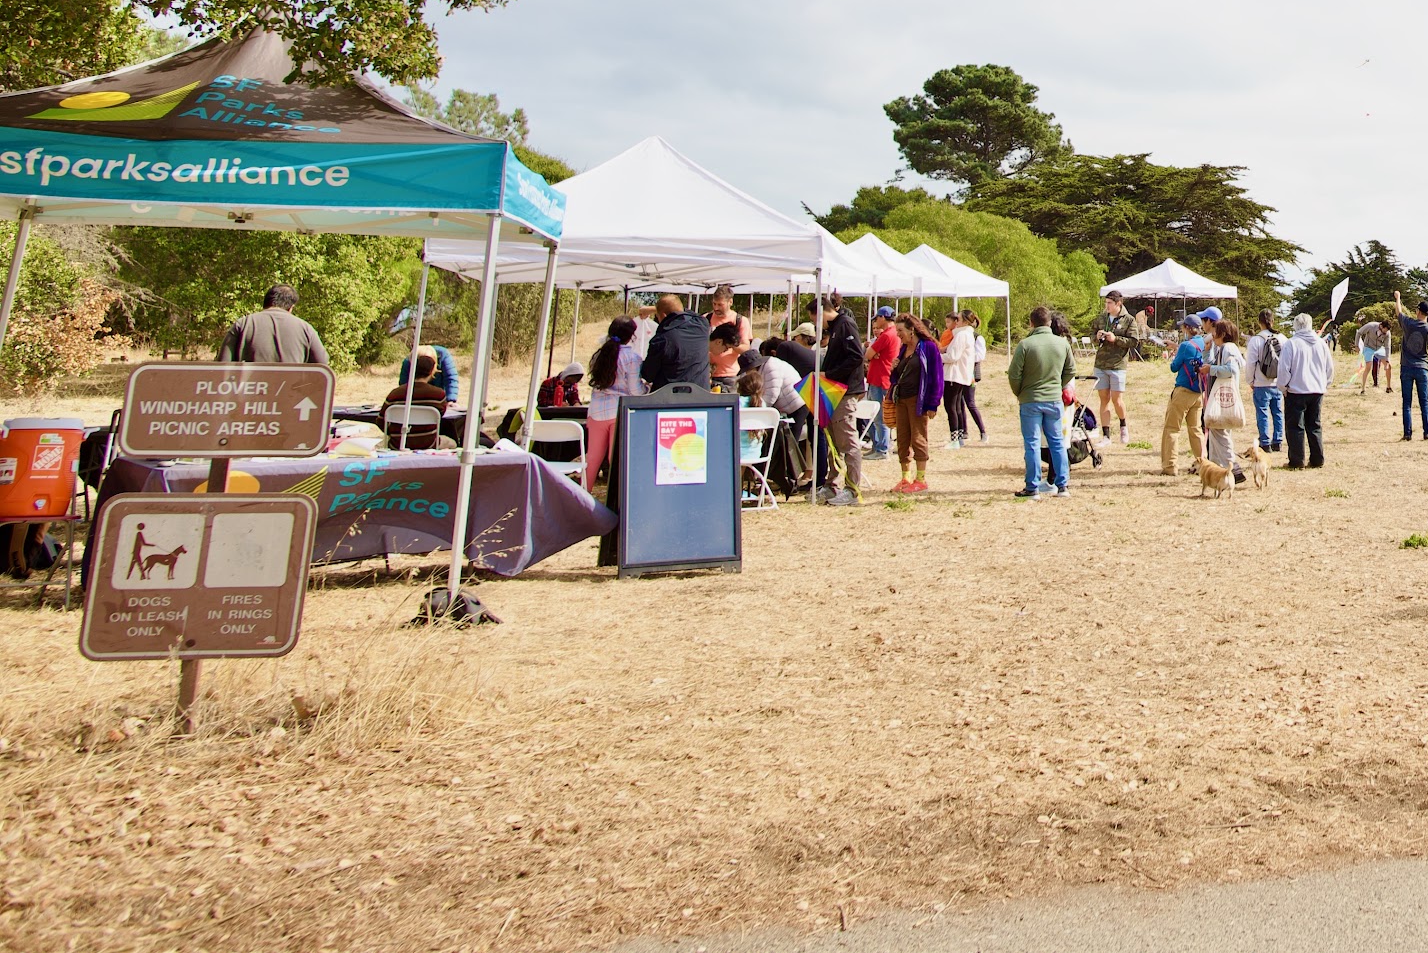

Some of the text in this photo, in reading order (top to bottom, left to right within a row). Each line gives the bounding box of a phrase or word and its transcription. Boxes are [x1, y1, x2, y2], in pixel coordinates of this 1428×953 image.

[208, 74, 264, 92] SF
[195, 91, 305, 120] Parks
[178, 107, 342, 134] Alliance
[0, 147, 350, 187] sfparksalliance
[195, 381, 269, 395] PLOVER
[139, 400, 283, 415] WINDHARP HILL
[148, 421, 281, 436] PICNIC AREAS
[338, 460, 390, 486] SF
[127, 596, 172, 608] DOGS
[222, 594, 263, 605] FIRES
[109, 611, 187, 623] ON LEASH
[207, 608, 273, 620] IN RINGS
[126, 625, 165, 637] ONLY
[219, 623, 257, 635] ONLY
